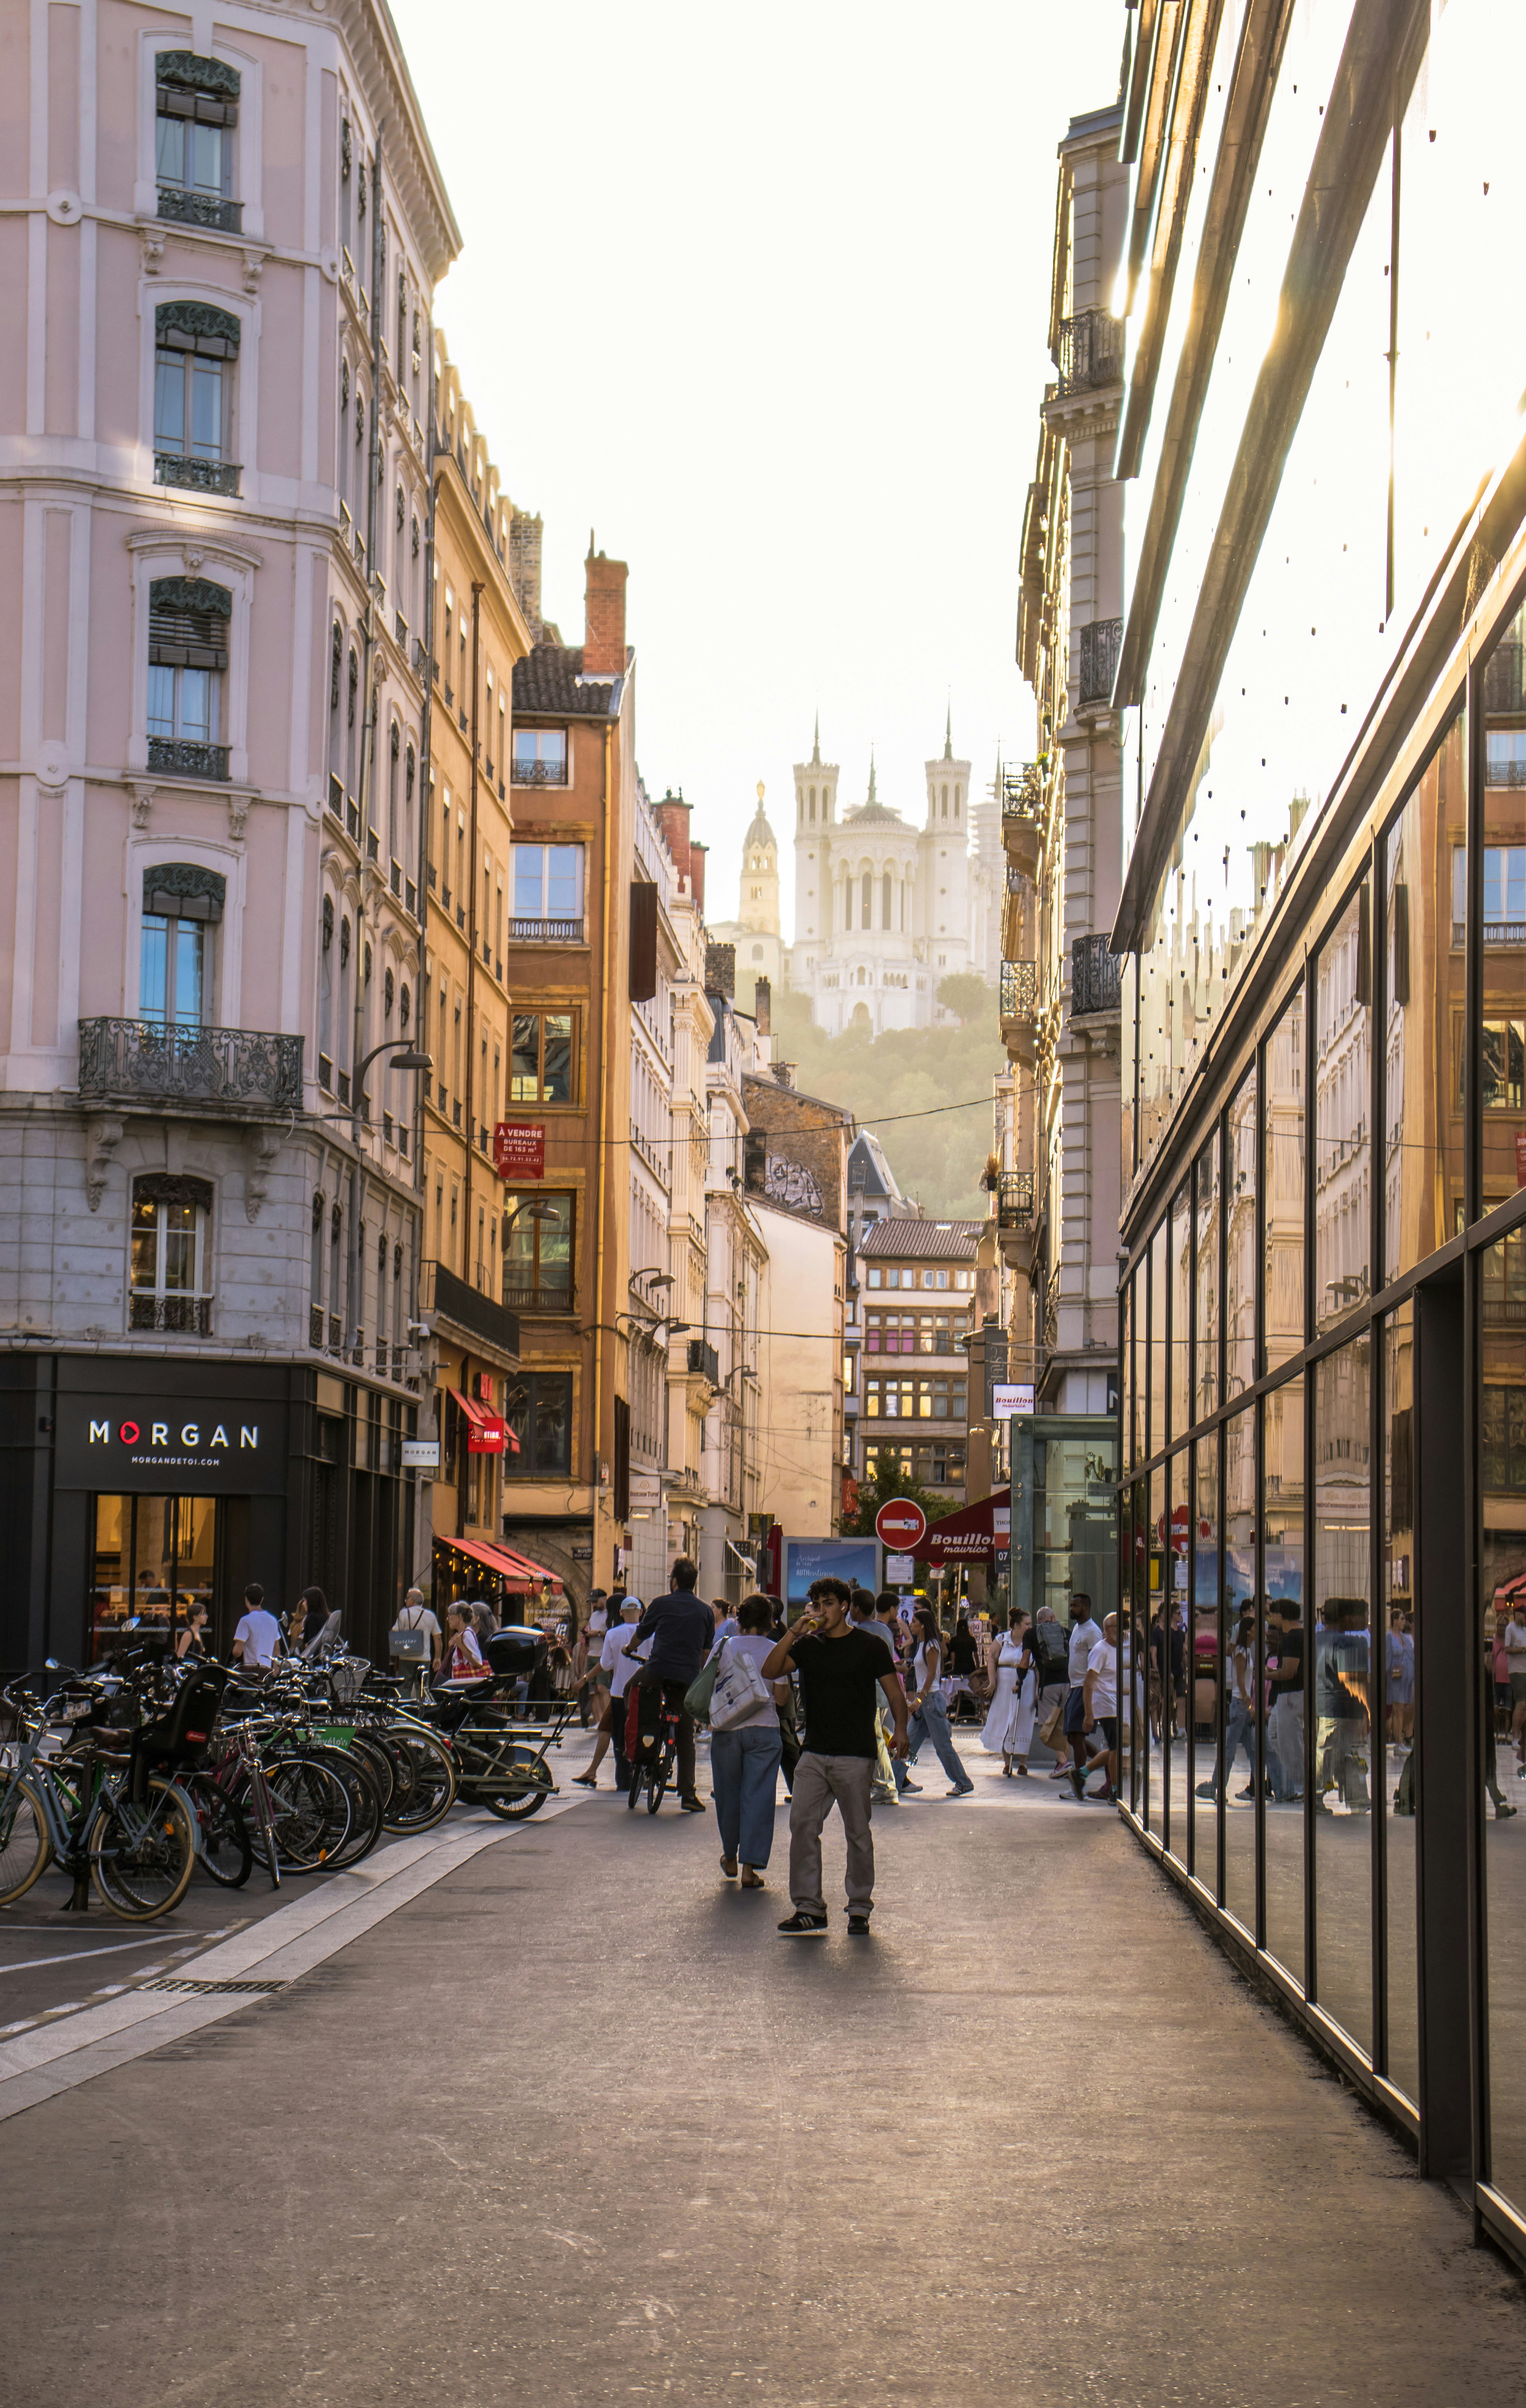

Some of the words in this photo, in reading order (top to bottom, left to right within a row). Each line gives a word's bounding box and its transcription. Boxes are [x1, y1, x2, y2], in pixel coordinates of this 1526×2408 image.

[499, 1126, 505, 1136] À
[508, 1129, 542, 1138] VENDRE
[89, 1420, 258, 1448] MORGAN
[132, 1456, 220, 1466] MORGANDETOI.COM
[944, 1545, 988, 1553] maurice
[998, 1552, 1008, 1561] 07
